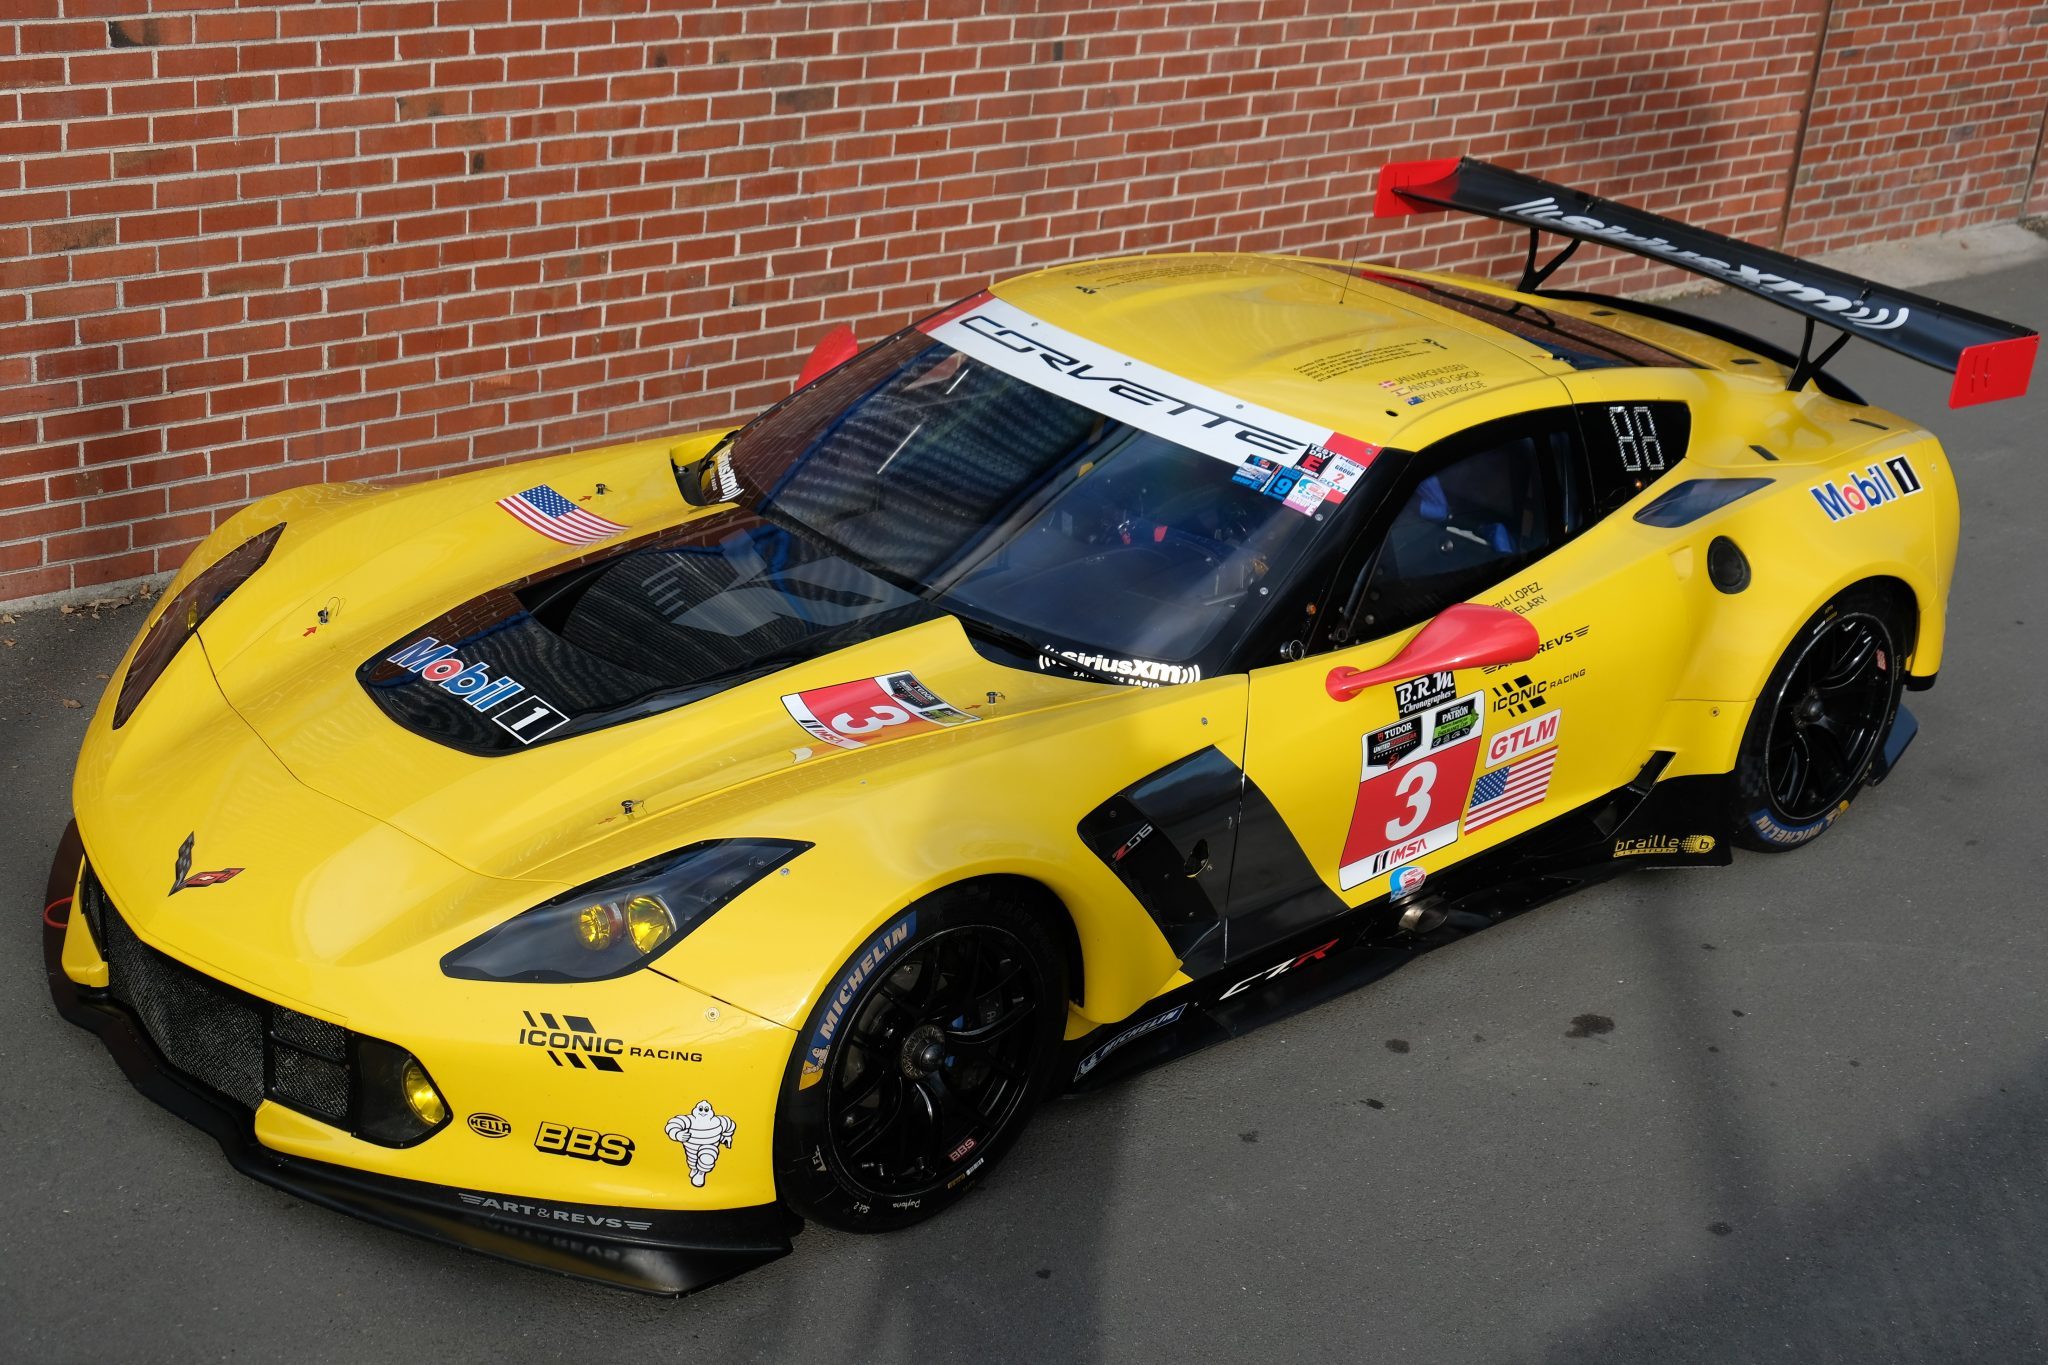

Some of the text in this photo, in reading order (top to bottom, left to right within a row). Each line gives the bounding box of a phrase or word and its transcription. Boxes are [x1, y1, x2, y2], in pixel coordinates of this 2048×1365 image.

[958, 315, 1306, 455] CORVETTE
[1408, 376, 1451, 393] ANTONIO
[1420, 379, 1487, 401] RYAN BRISCOE
[1308, 449, 1329, 461] DAY
[1311, 443, 1336, 457] TEST
[1301, 454, 1324, 472] E
[1335, 464, 1355, 477] GROUP
[1273, 478, 1293, 495] 9
[1320, 477, 1348, 493] 2017
[1333, 473, 1345, 484] 2
[1811, 460, 1915, 521] Mobil 1
[1509, 582, 1543, 602] LOPEZ
[386, 636, 551, 732] Mobil 1
[1128, 678, 1160, 689] RADIO
[1493, 668, 1586, 713] ICONIC RACING
[831, 705, 910, 735] 3
[812, 730, 844, 743] IMSA
[1384, 722, 1412, 739] TUDOR
[1491, 715, 1557, 760] GTLM
[1385, 761, 1437, 841] 3
[1756, 815, 1824, 844] MICHELIN
[1390, 839, 1427, 864] IMSA
[1614, 835, 1680, 852] braille
[820, 922, 909, 1040] MICHELIN
[519, 1028, 703, 1062] ICONIC RACING
[470, 1114, 512, 1134] HELLA
[534, 1121, 635, 1167] BBS
[948, 1138, 977, 1162] BBS
[892, 1199, 921, 1211] Daytona
